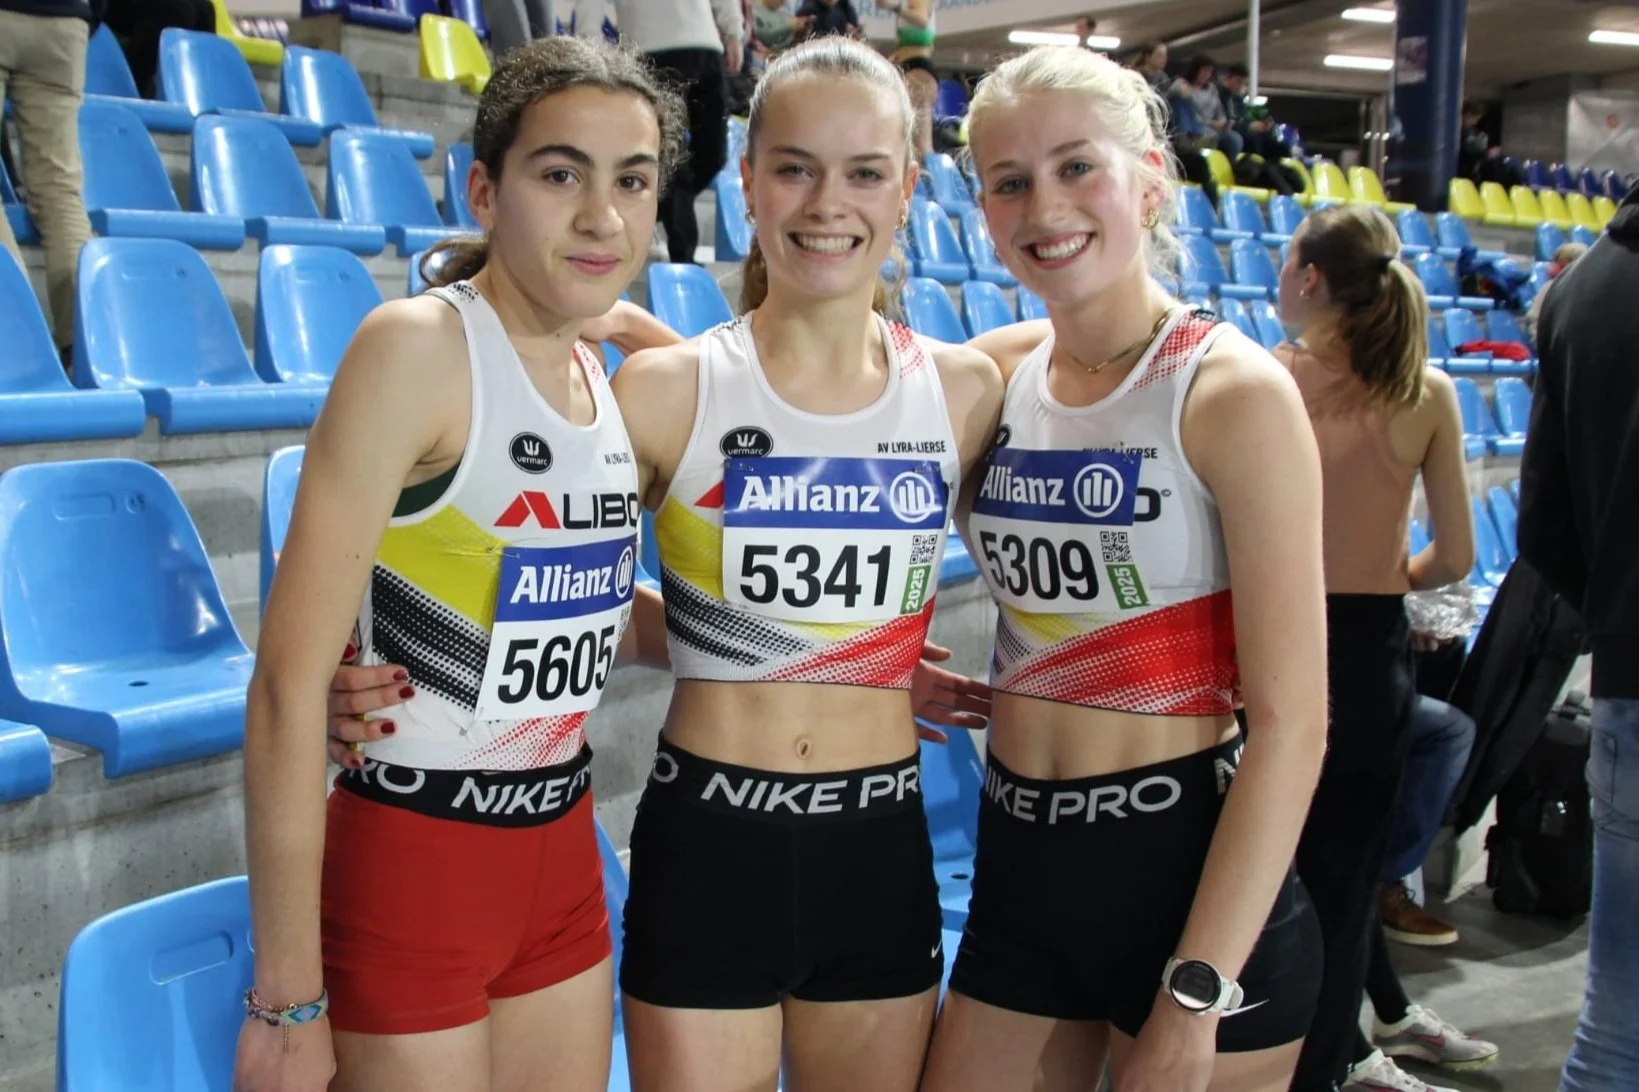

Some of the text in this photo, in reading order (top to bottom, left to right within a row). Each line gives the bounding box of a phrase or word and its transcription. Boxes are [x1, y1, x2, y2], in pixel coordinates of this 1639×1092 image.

[516, 456, 548, 466] vermarc
[877, 440, 947, 454] AV LYRA-LIERSE
[738, 475, 881, 513] Allianz
[980, 465, 1066, 506] Allianz
[509, 563, 613, 604] Allianz
[739, 544, 892, 609] 5341
[979, 530, 1100, 601] 5309
[905, 568, 925, 611] 2025
[1113, 567, 1142, 607] 2025
[498, 624, 616, 704] 5605
[451, 776, 570, 815] NIKE
[700, 772, 848, 814] NIKE
[1049, 775, 1182, 825] PRO
